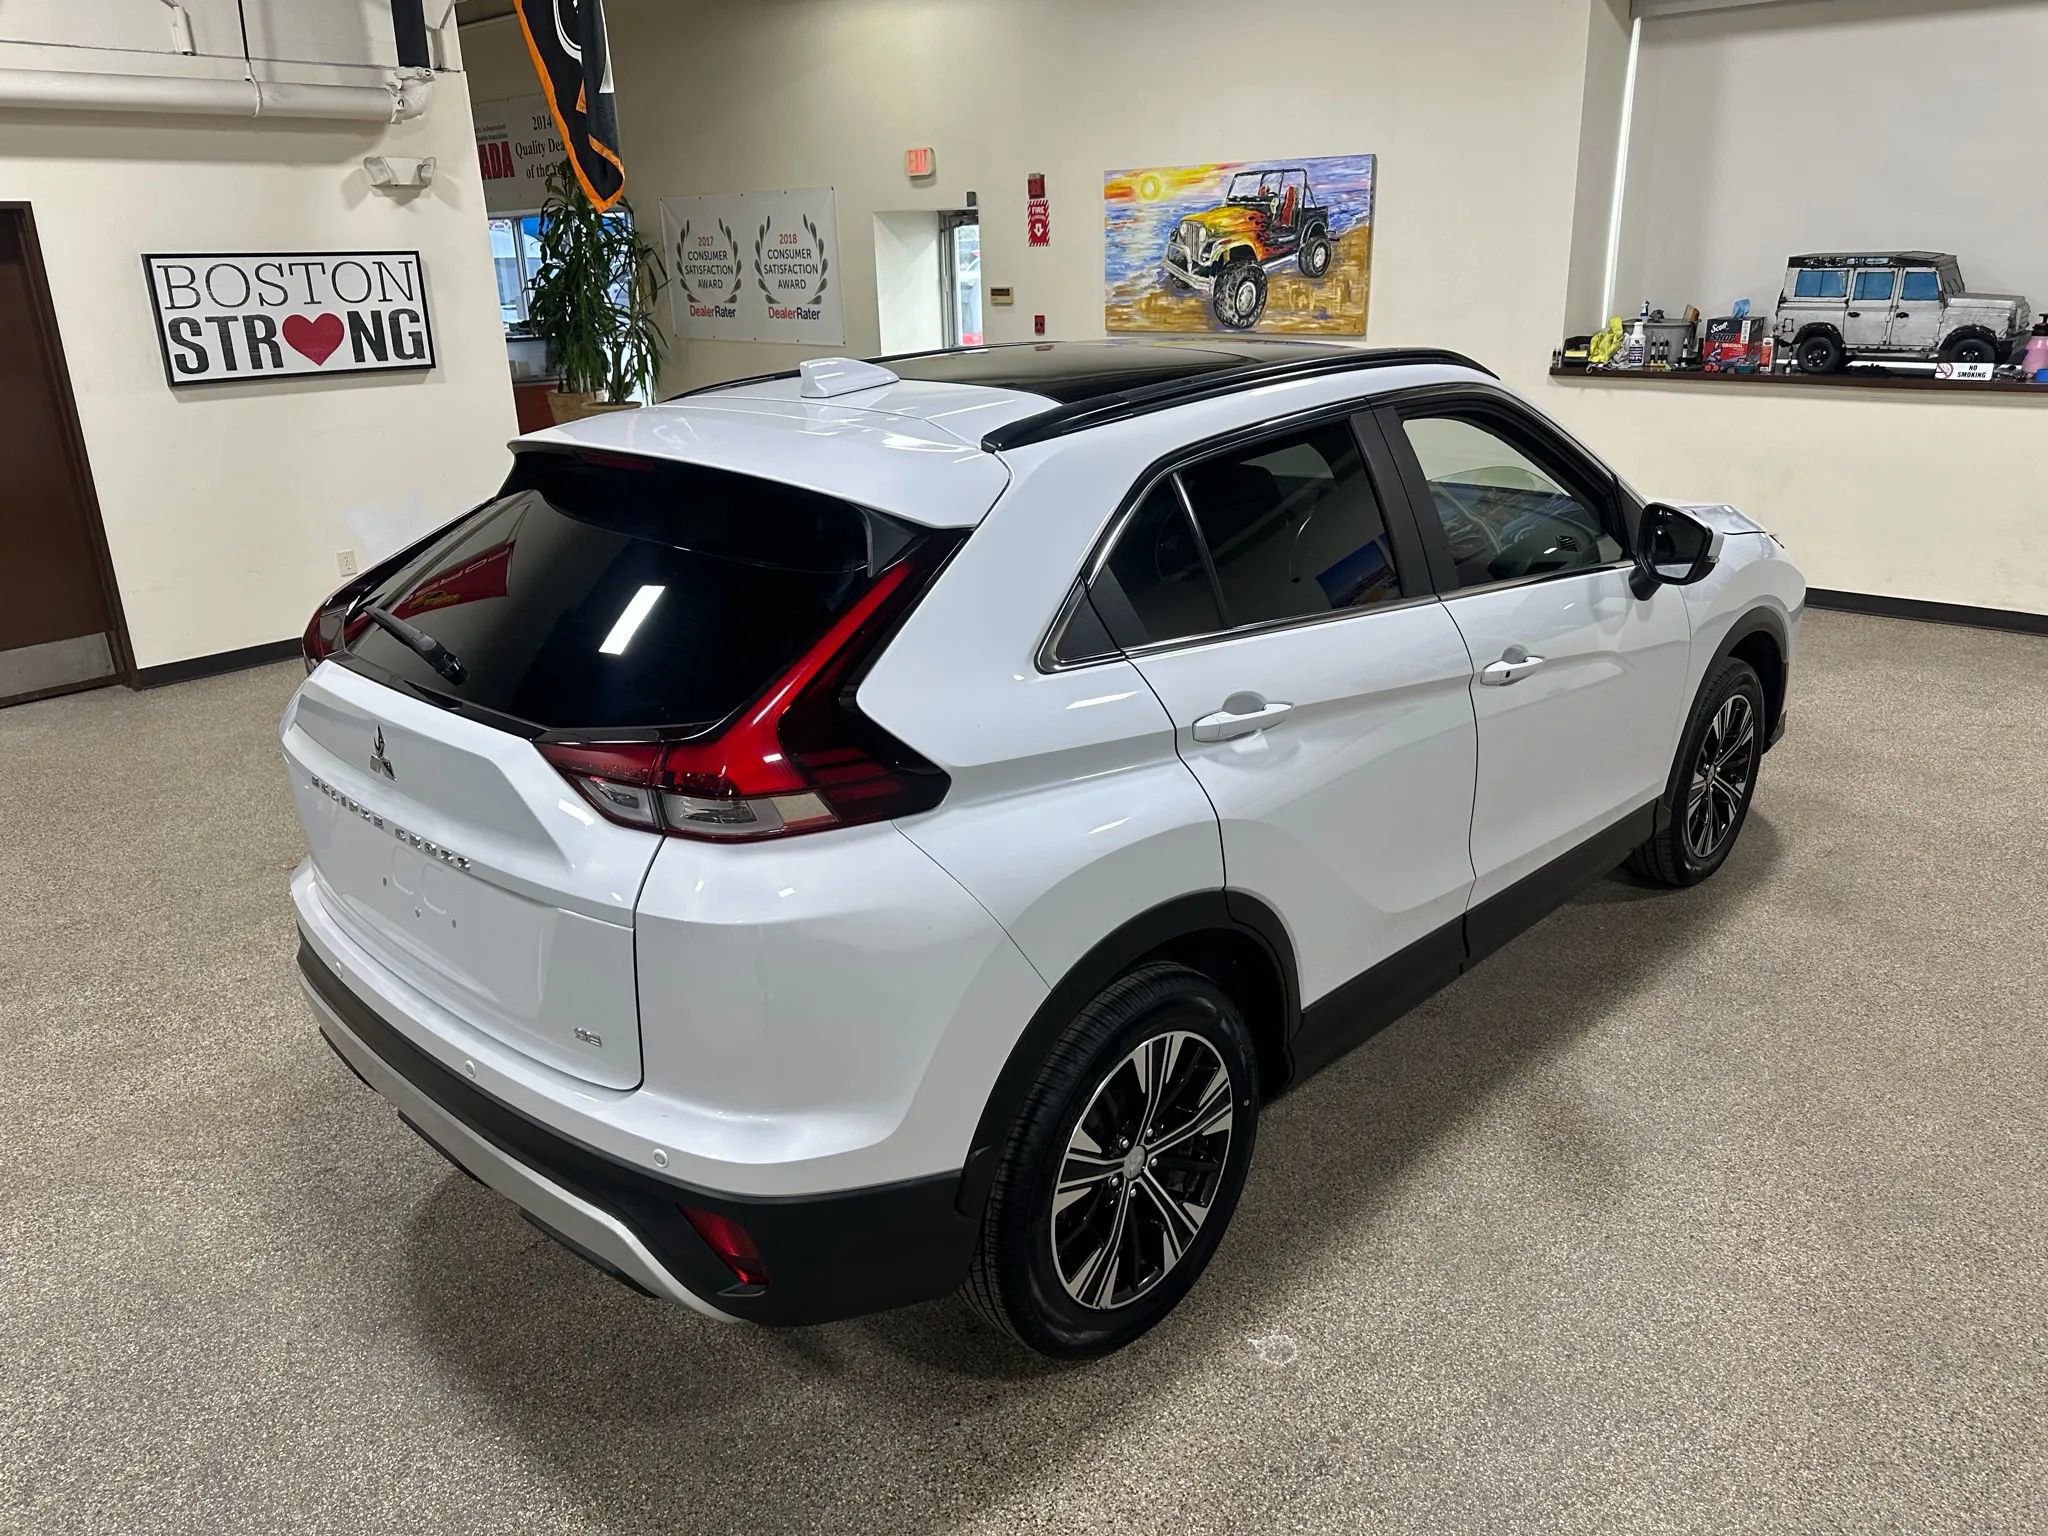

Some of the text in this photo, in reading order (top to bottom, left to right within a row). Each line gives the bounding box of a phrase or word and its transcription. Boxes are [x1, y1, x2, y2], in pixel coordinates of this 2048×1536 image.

[532, 114, 553, 131] 2014
[515, 138, 566, 160] Quality Dea
[478, 140, 516, 181] ADA
[526, 164, 535, 179] of
[536, 163, 550, 177] the
[697, 236, 714, 247] 2017
[779, 233, 798, 245] 2018
[687, 250, 728, 261] CONSUMER
[767, 248, 812, 260] CONSUMER
[685, 264, 734, 275] SATISFACTION
[763, 263, 818, 275] SATISFACTION
[156, 261, 414, 310] BOSTON
[697, 279, 723, 289] AWARD
[778, 279, 807, 290] AWARD
[689, 304, 736, 319] DealerRater
[768, 306, 821, 321] DealerRater
[1957, 371, 1987, 379] SMOKING
